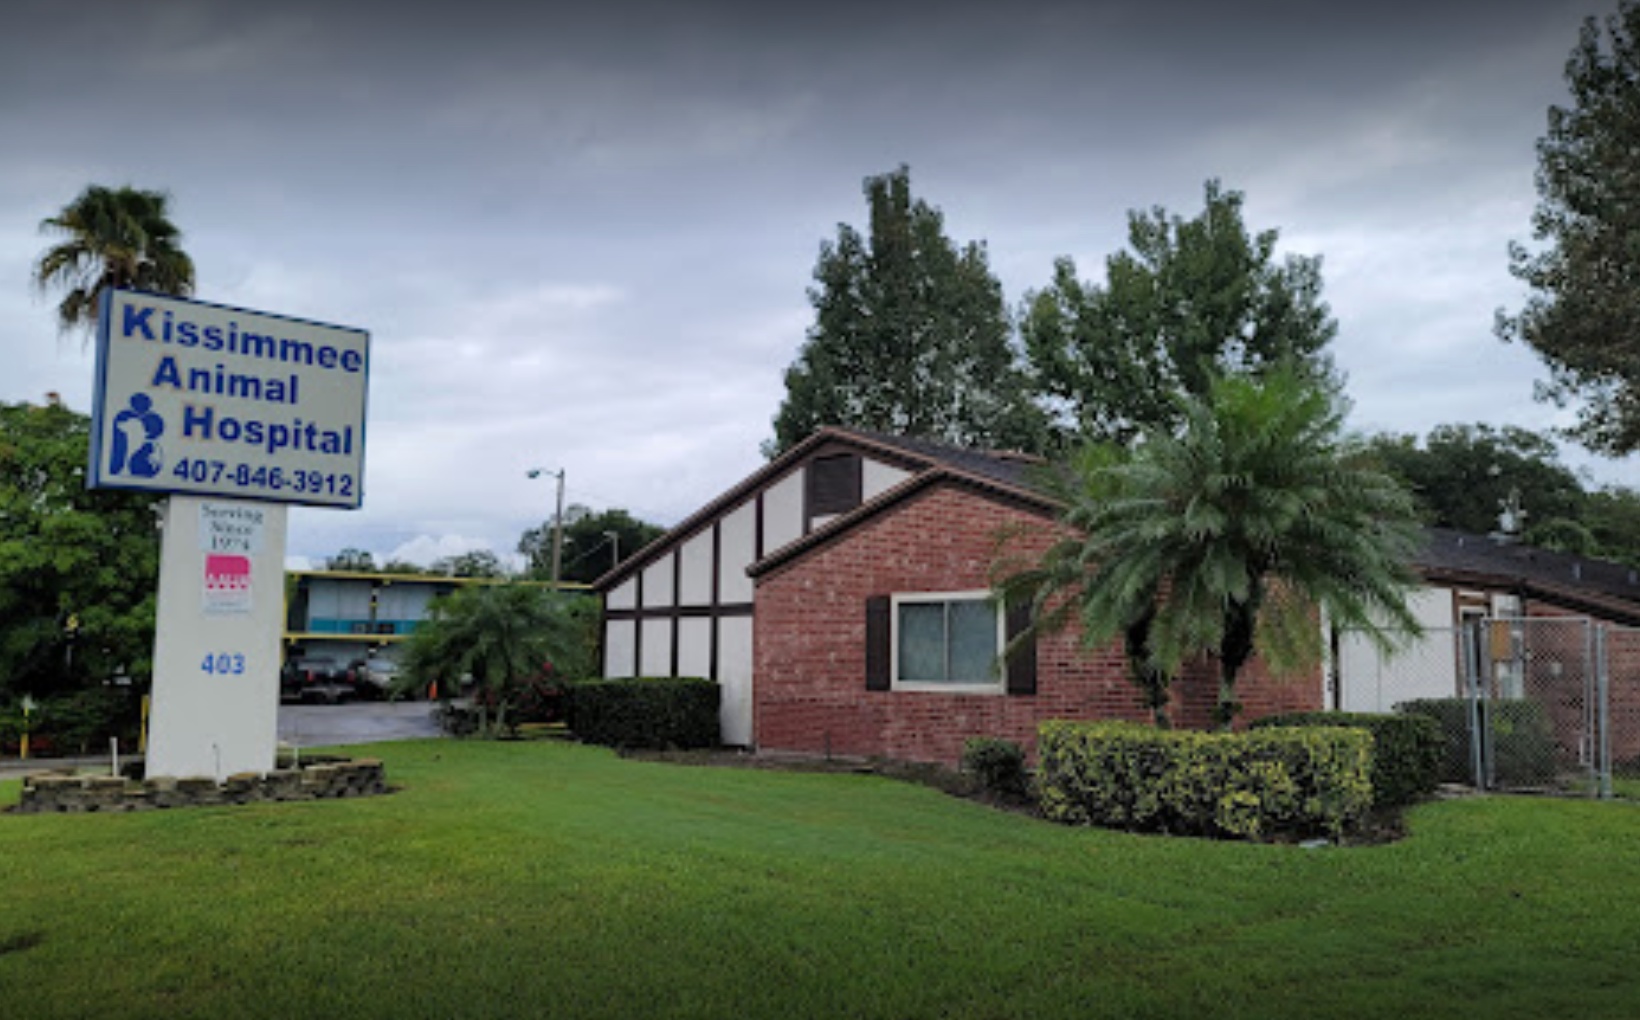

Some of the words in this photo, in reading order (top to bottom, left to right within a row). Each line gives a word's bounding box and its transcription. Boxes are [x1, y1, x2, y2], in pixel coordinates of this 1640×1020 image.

[122, 304, 362, 373] Kissimmee
[152, 356, 299, 404] Animal
[183, 406, 352, 454] Hospital
[173, 458, 353, 496] 407-846-3912
[201, 653, 246, 675] 403
